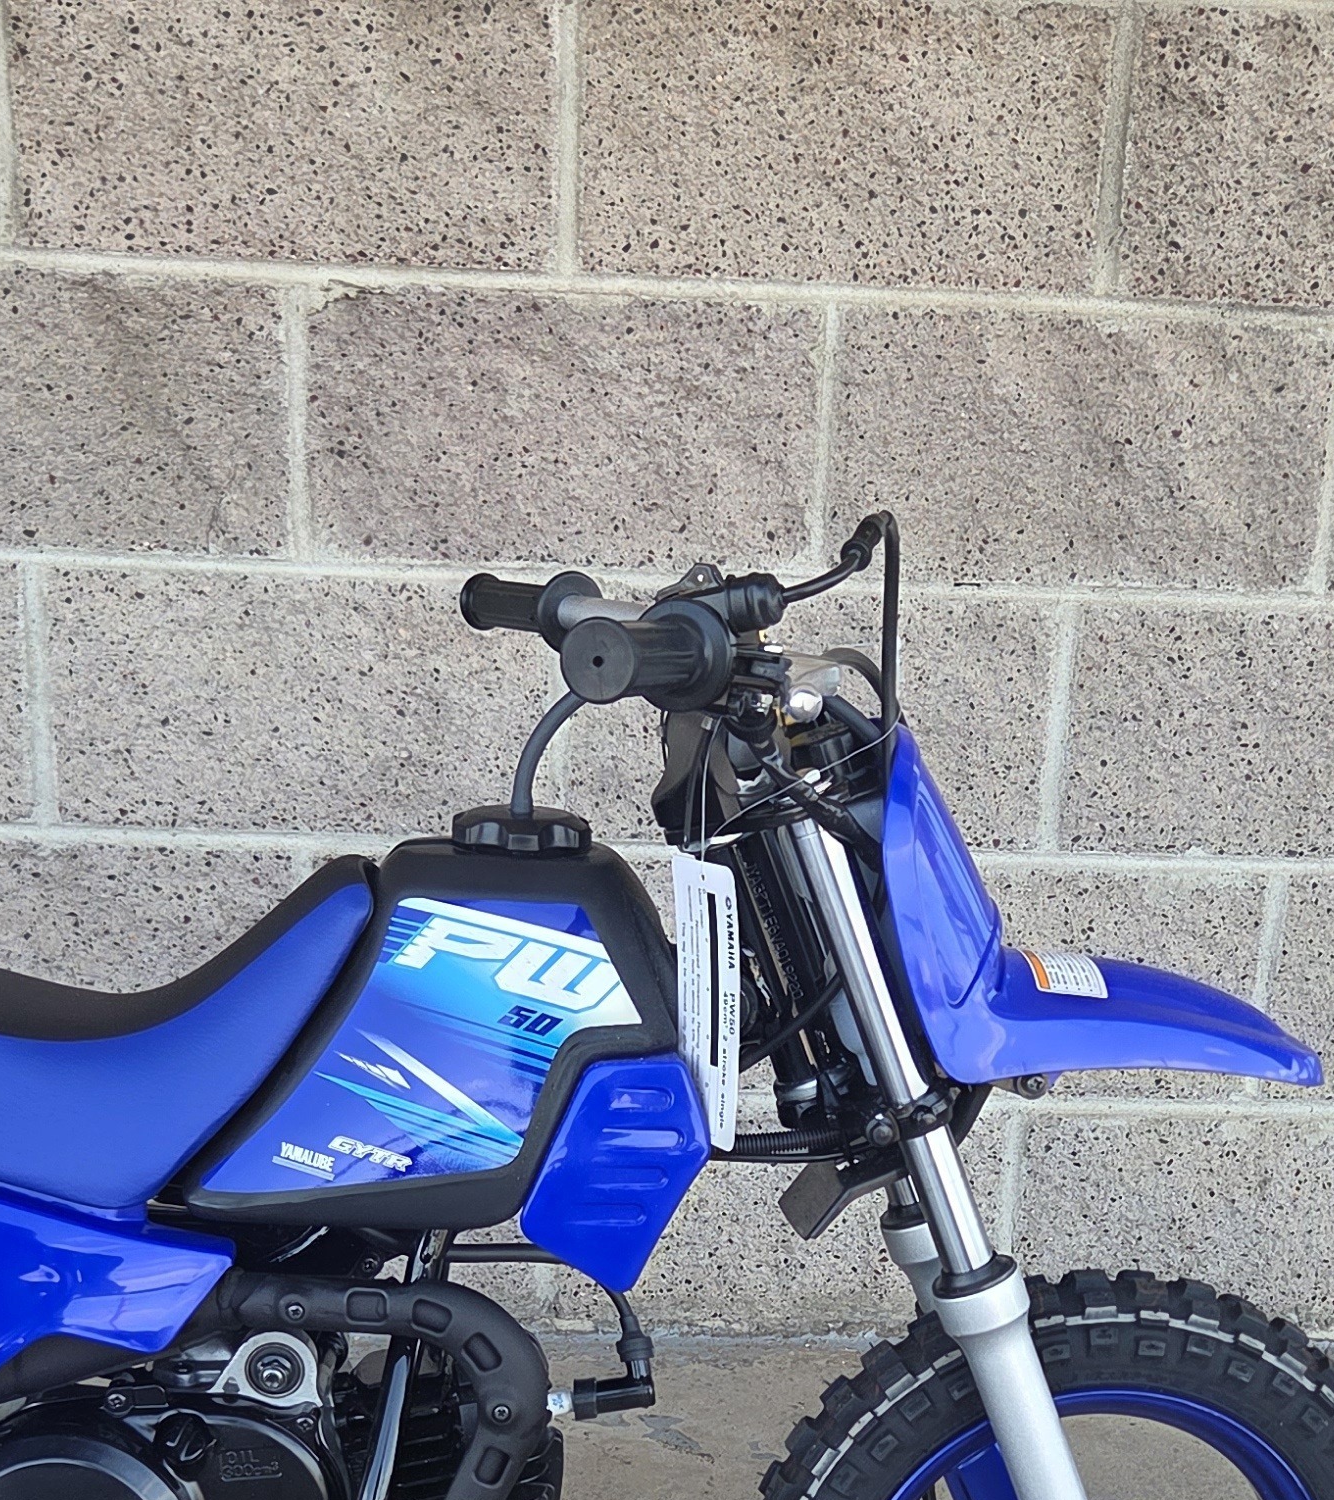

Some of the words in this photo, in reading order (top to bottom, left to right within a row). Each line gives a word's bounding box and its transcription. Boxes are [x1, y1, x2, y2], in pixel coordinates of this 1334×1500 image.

[725, 912, 736, 970] YAMAHA
[391, 915, 621, 1012] PW
[497, 1005, 563, 1037] 50
[728, 992, 736, 1036] PW50
[279, 1141, 336, 1173] YAMALUBE
[328, 1135, 413, 1173] GYTR
